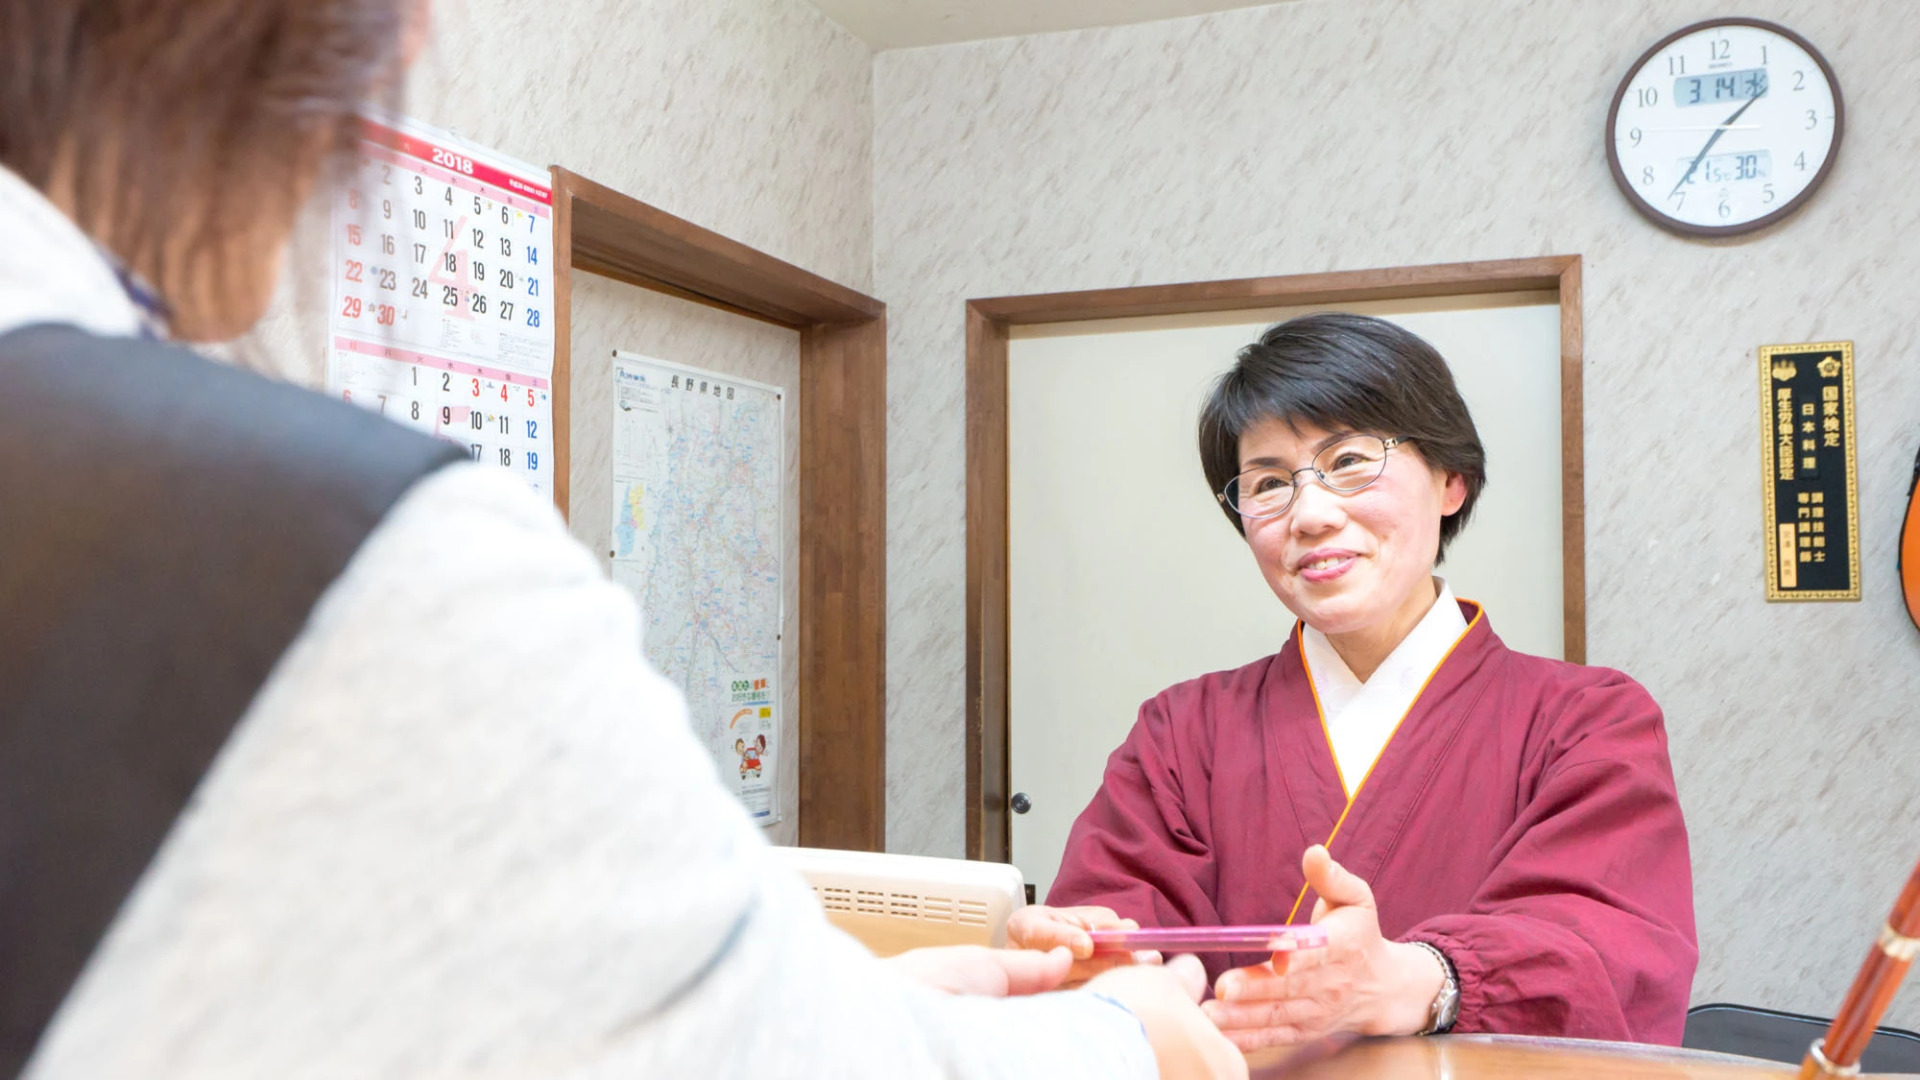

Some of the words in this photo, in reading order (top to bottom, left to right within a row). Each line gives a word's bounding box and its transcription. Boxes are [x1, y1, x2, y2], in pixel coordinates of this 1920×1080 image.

[1709, 39, 1730, 60] 12
[1760, 45, 1768, 65] 1
[1668, 55, 1686, 75] 11
[1689, 79, 1701, 104] 3
[1714, 77, 1735, 99] 14
[1792, 71, 1805, 91] 2
[1637, 87, 1658, 108] 10
[1805, 109, 1817, 130] 3
[1629, 128, 1642, 148] 9
[432, 148, 474, 175] 2018
[1794, 151, 1806, 171] 4
[1642, 166, 1654, 185] 8
[415, 176, 423, 195] 3
[445, 187, 453, 206] 4
[474, 197, 481, 214] 5
[501, 207, 508, 224] 6
[528, 215, 535, 234] 7
[1673, 191, 1686, 212] 7
[1762, 183, 1775, 204] 5
[1718, 199, 1730, 218] 6
[383, 200, 391, 219] 9
[413, 209, 426, 230] 10
[443, 219, 455, 239] 11
[473, 229, 484, 249] 12
[500, 238, 511, 256] 13
[527, 246, 537, 265] 14
[347, 224, 361, 246] 15
[381, 234, 395, 255] 16
[413, 243, 426, 264] 17
[444, 253, 456, 272] 18
[473, 262, 484, 281] 19
[499, 270, 513, 289] 20
[527, 278, 538, 296] 21
[345, 259, 362, 284] 22
[379, 269, 396, 291] 23
[412, 278, 428, 299] 24
[443, 286, 458, 307] 25
[472, 294, 487, 314] 26
[500, 301, 514, 321] 27
[527, 309, 540, 328] 28
[342, 296, 362, 319] 29
[377, 304, 395, 326] 30
[412, 367, 417, 386] 1
[442, 373, 450, 391] 2
[472, 378, 480, 397] 3
[500, 384, 508, 402] 4
[528, 391, 535, 407] 5
[671, 375, 735, 401] 長野県地図
[378, 395, 387, 415] 7
[411, 401, 419, 420] 8
[443, 406, 450, 425] 9
[471, 411, 482, 430] 10
[499, 416, 509, 434] 11
[527, 421, 537, 439] 12
[1822, 386, 1840, 447] 国家検定
[1802, 403, 1816, 469] 日本料理
[471, 444, 482, 462] 17
[499, 448, 510, 467] 18
[527, 452, 538, 470] 19
